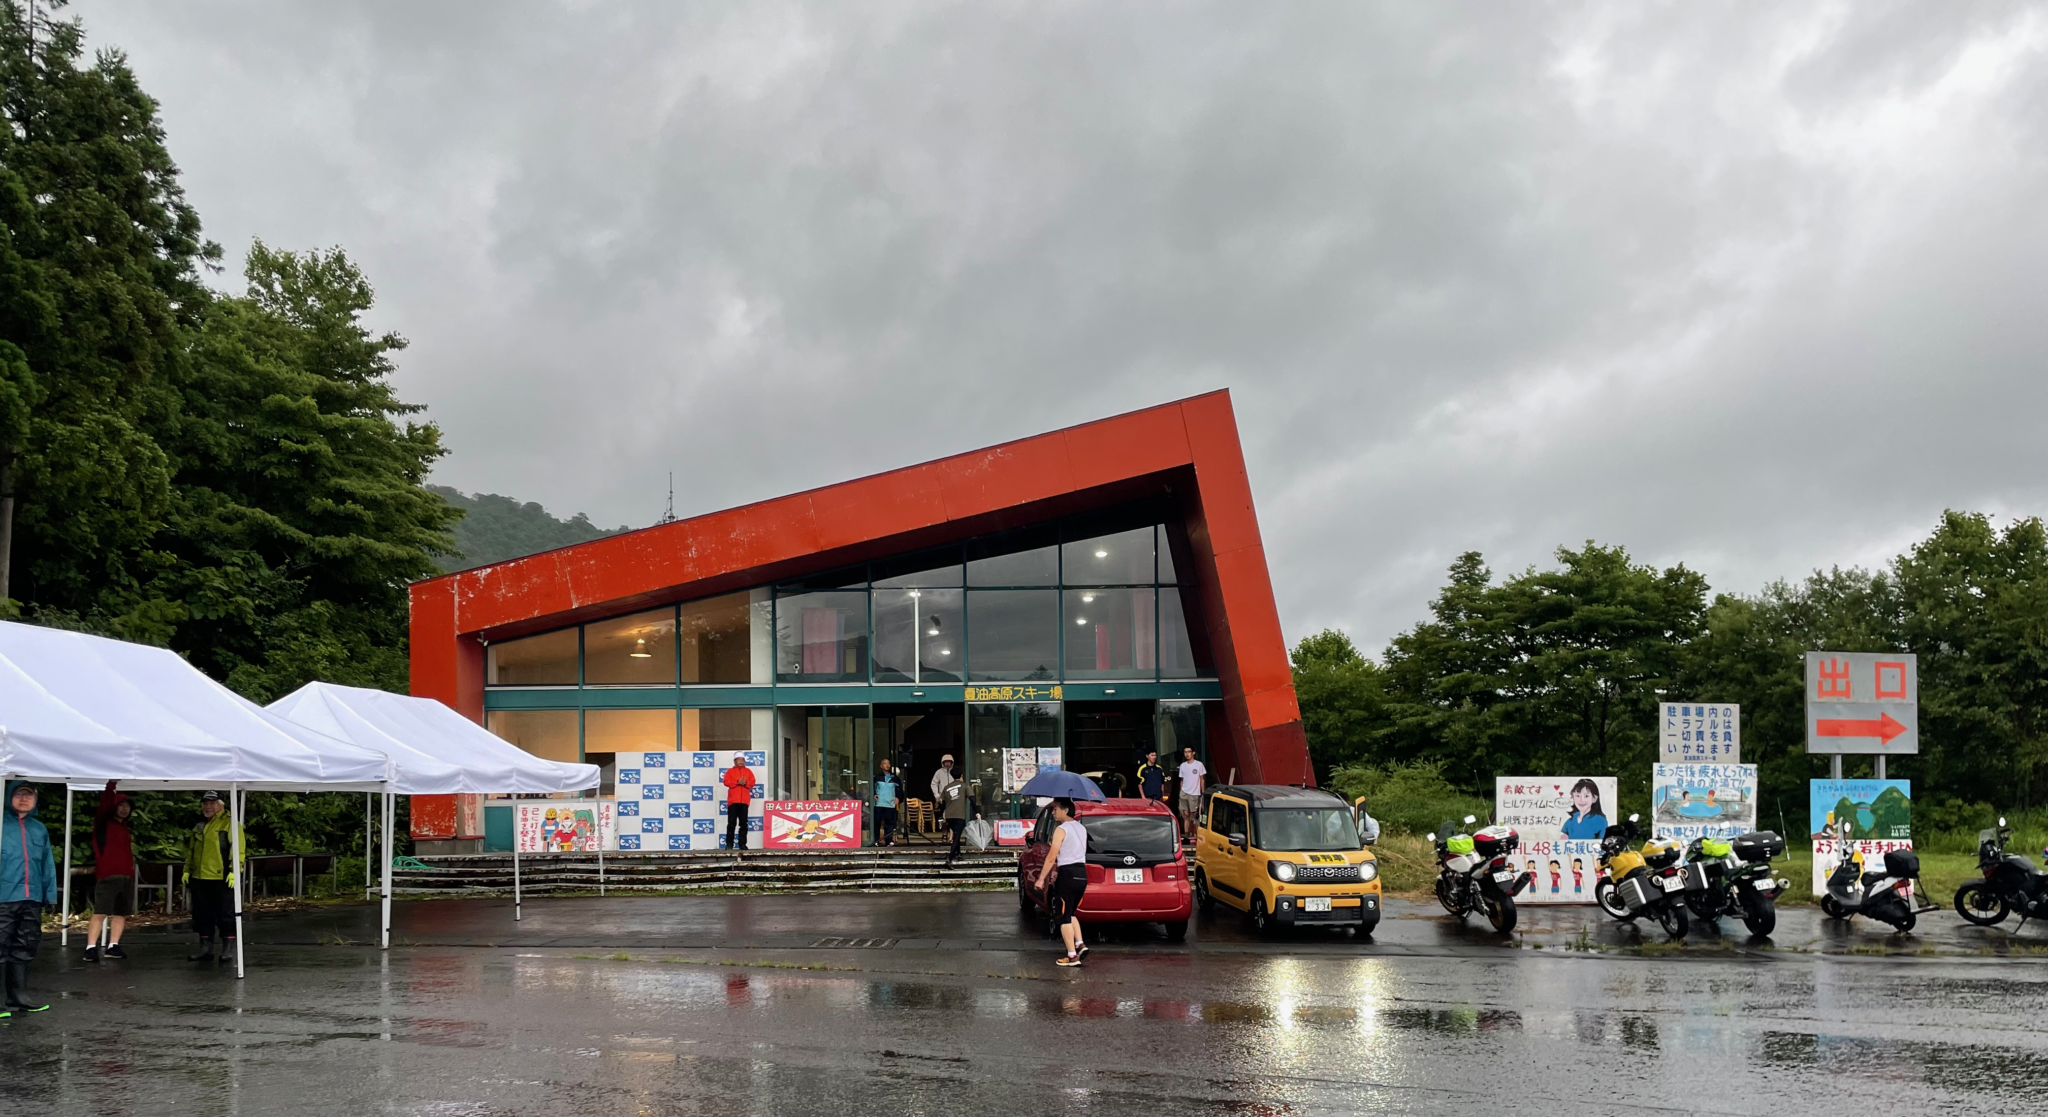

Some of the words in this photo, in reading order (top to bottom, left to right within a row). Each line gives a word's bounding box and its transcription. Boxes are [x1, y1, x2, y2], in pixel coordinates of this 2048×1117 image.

[1817, 658, 1906, 700] 出口
[964, 686, 1063, 701] 夏油高原スキー場
[1667, 706, 1732, 718] 駐車場内の
[1667, 718, 1732, 730] トラブルは
[1667, 730, 1732, 742] 一切責を負
[1667, 743, 1732, 754] いかねます
[1504, 785, 1542, 795] 素敵です
[1503, 799, 1555, 809] ヒルクライムに
[1504, 815, 1562, 826] 挑戦するあなた!
